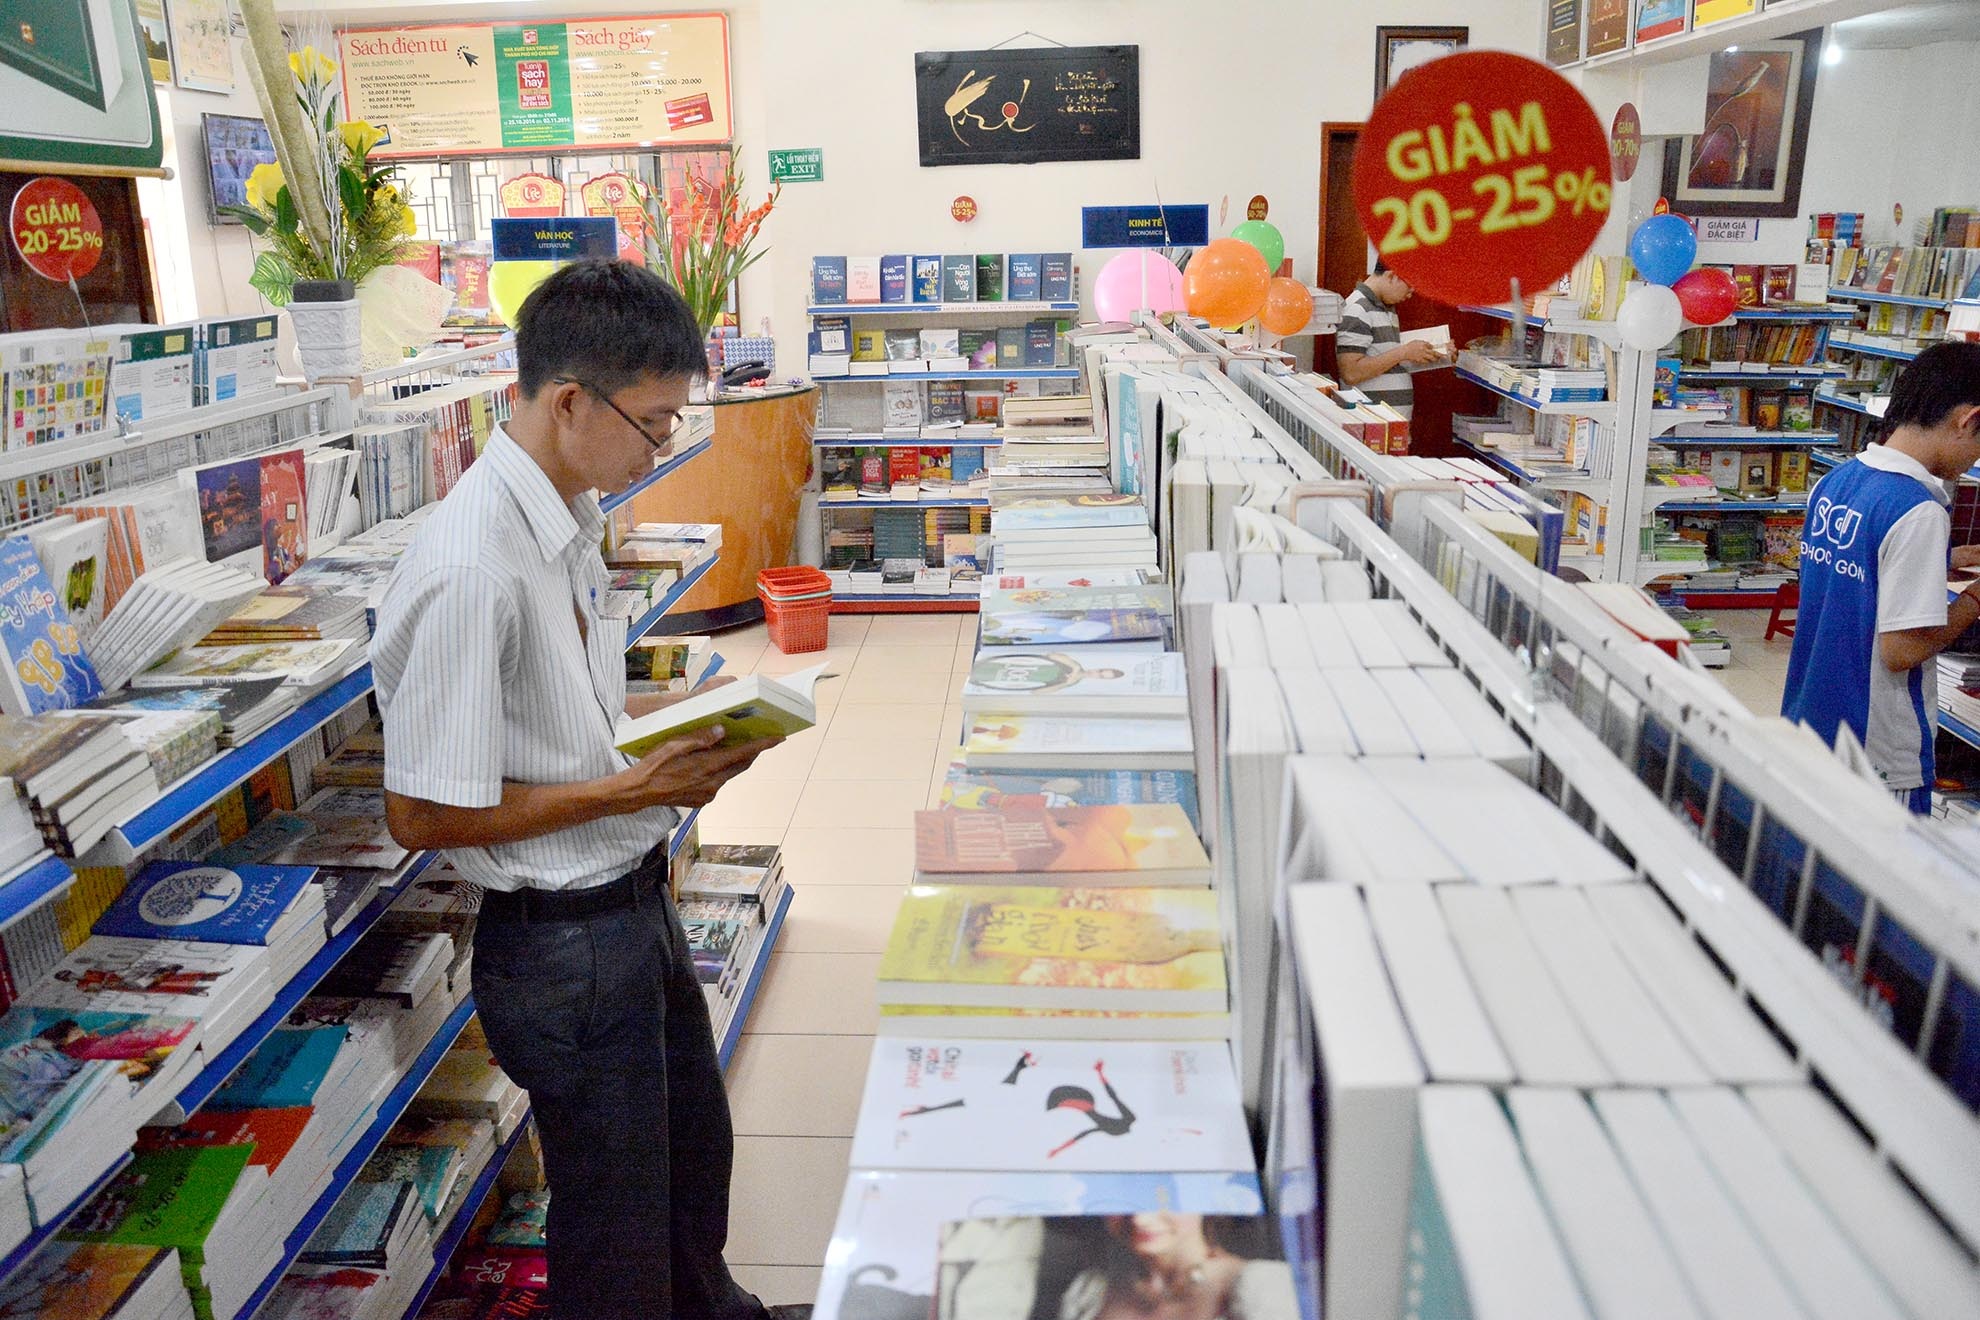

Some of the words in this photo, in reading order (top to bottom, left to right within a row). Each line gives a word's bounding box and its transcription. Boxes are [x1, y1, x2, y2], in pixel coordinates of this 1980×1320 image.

[576, 27, 614, 46] Sách
[351, 38, 390, 56] Sách
[392, 36, 427, 56] điện
[524, 78, 544, 88] hay
[1618, 120, 1634, 134] GIẢM
[1386, 101, 1553, 183] GIẢM
[790, 164, 816, 174] EXIT
[954, 200, 973, 208] GIẢM
[1371, 164, 1612, 256] 20-25%
[24, 197, 82, 226] GIẢM
[1128, 218, 1150, 227] KINH
[1152, 216, 1163, 227] TẾ
[1707, 220, 1730, 230] GIẢM
[1732, 221, 1746, 230] GIÁ
[19, 226, 103, 254] 20-25%
[535, 230, 554, 240] VĂN
[555, 232, 574, 242] HỌC
[1708, 230, 1726, 240] ĐẶC
[1727, 230, 1745, 240] BIỆT
